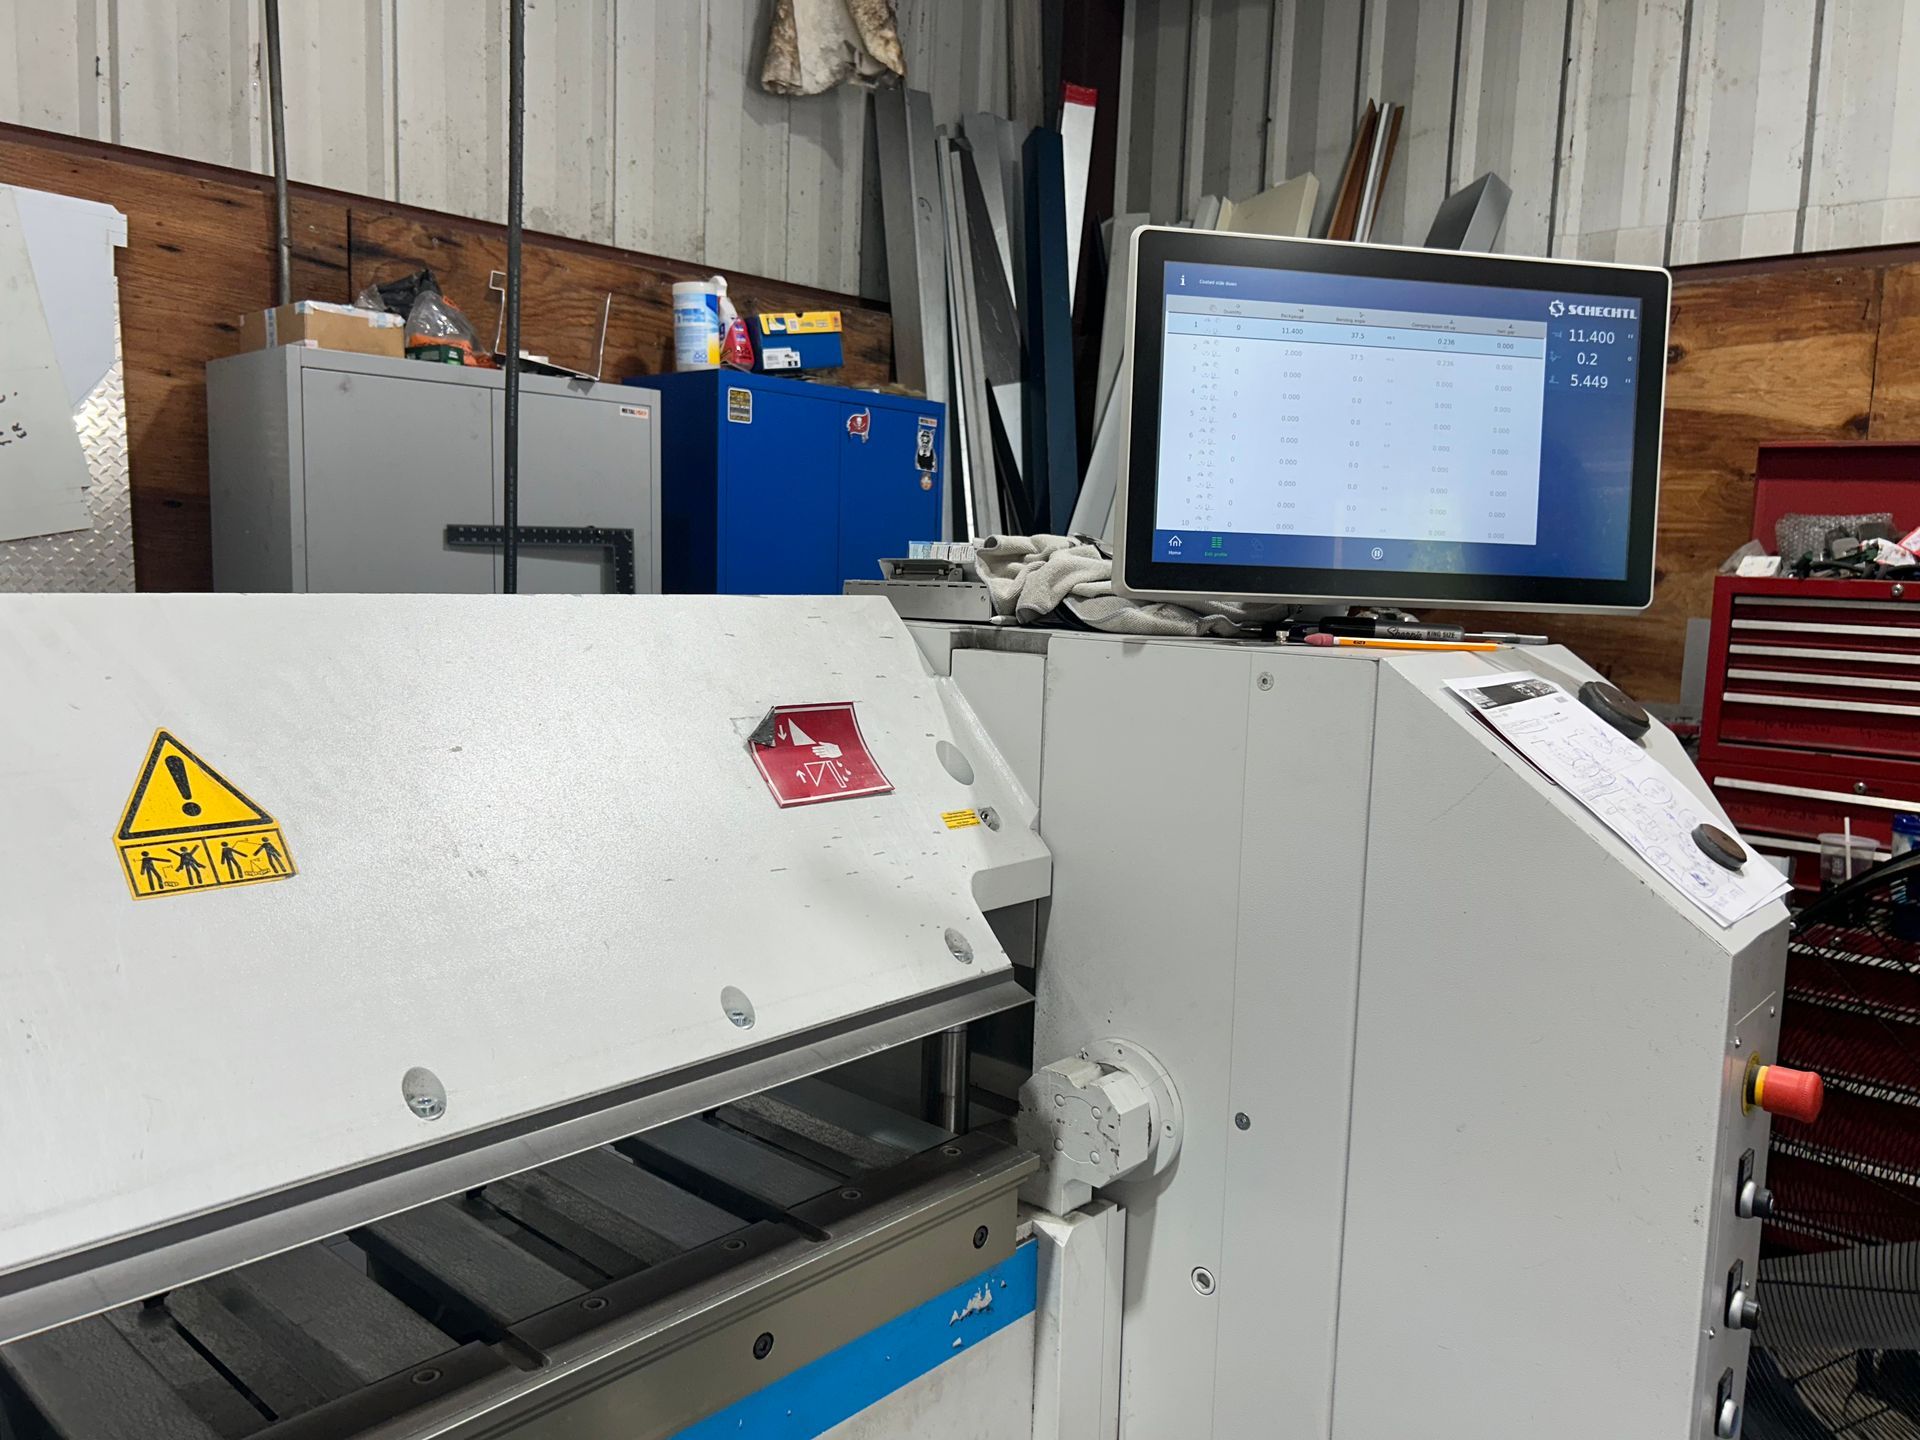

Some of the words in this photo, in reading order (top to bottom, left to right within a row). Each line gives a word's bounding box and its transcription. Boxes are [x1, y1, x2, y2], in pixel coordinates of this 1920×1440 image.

[1567, 304, 1638, 320] SCHECHTL
[1282, 327, 1304, 335] 11.400
[1351, 332, 1365, 340] 37.5
[1437, 337, 1456, 346] 0.236
[1496, 342, 1515, 350] 0.000
[1568, 328, 1615, 345] 11.400
[1577, 352, 1598, 366] 0.2
[1570, 374, 1608, 389] 5.449
[1386, 625, 1424, 640] Sharpie
